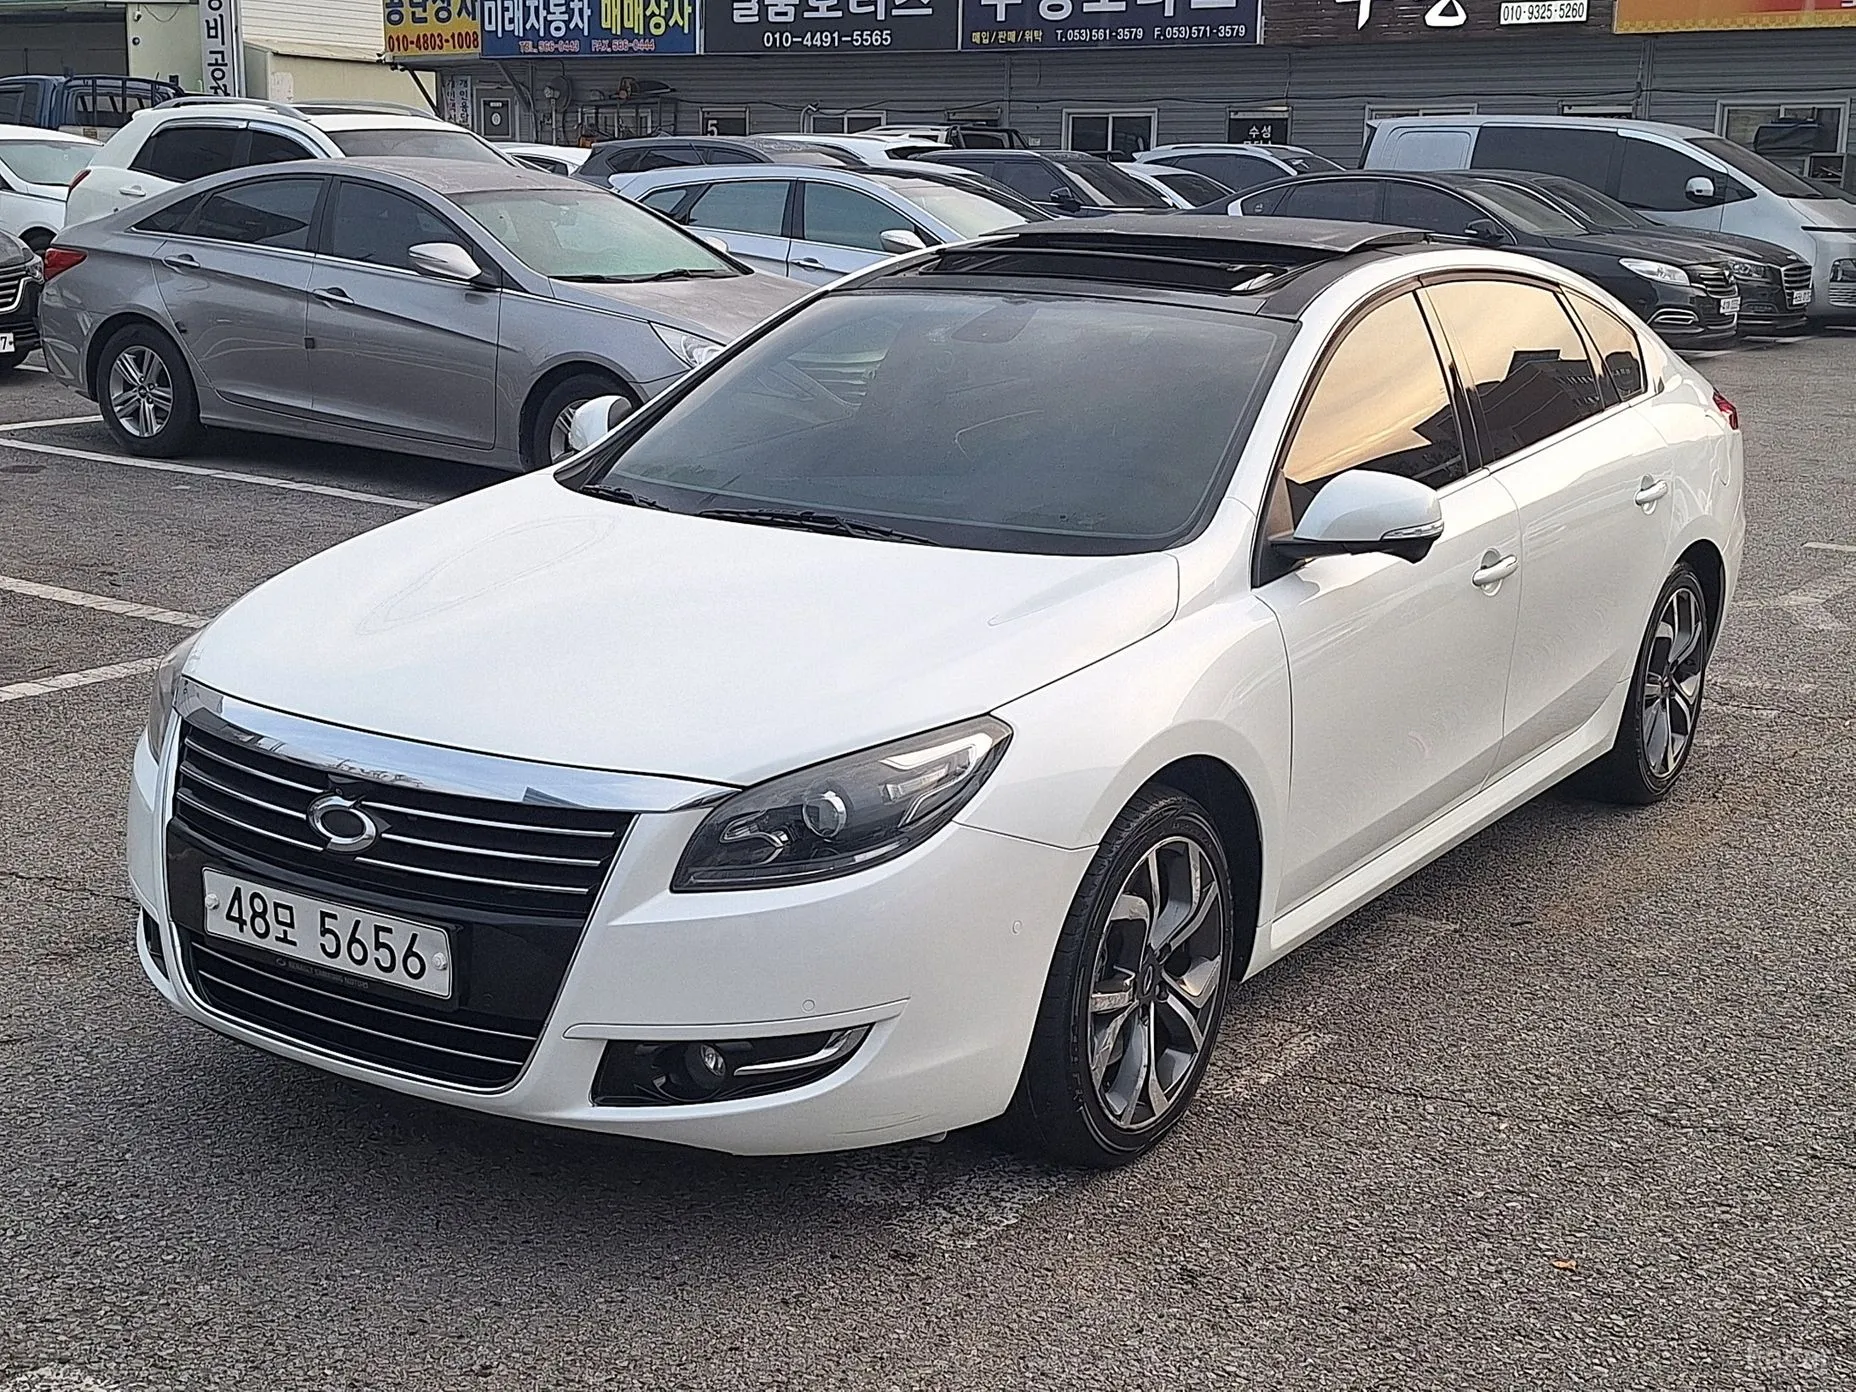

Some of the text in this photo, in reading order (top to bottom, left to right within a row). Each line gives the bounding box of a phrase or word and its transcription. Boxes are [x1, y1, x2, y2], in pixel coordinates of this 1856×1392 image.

[484, 0, 591, 37] 미래자동차
[601, 0, 692, 36] 매매상사
[388, 31, 479, 52] 010-4803-1008
[763, 30, 891, 47] 010-4491-5565
[1249, 125, 1272, 138] 수성
[225, 886, 427, 980] 48모 5656
